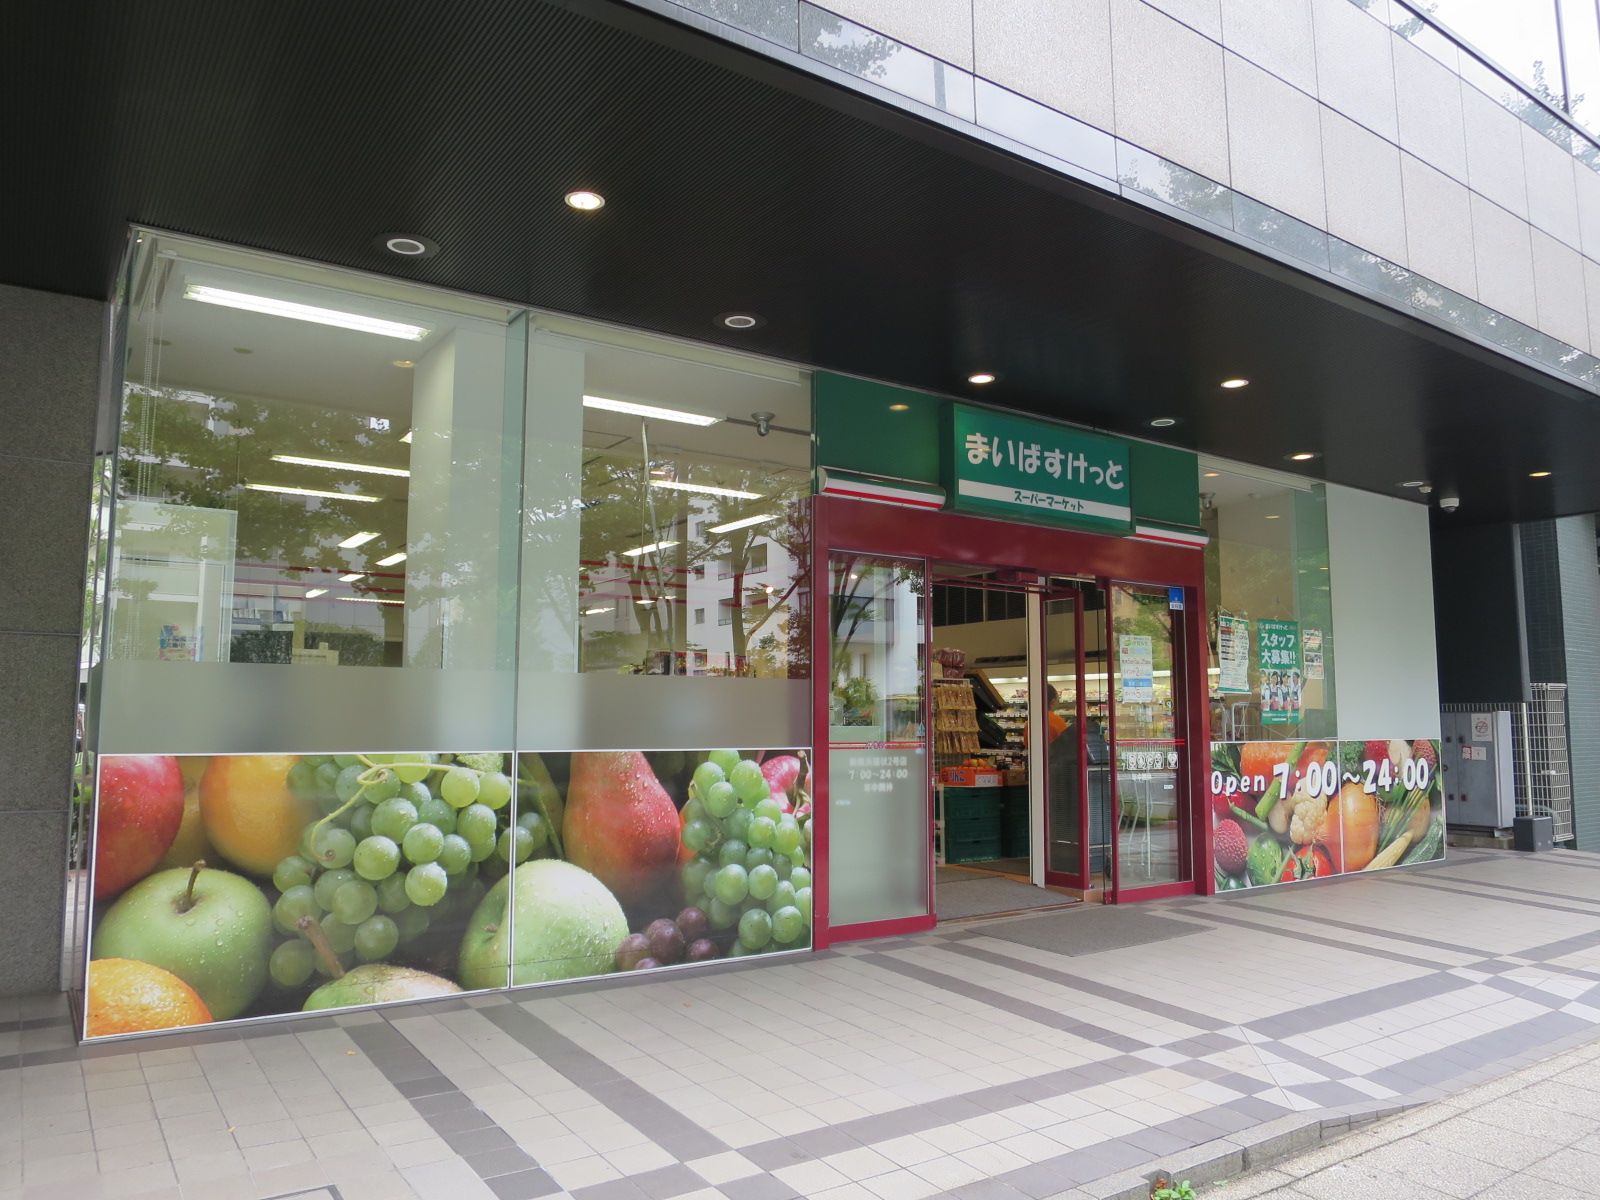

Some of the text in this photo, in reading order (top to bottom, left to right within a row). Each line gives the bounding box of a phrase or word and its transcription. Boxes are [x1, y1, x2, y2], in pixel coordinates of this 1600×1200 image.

[965, 432, 1125, 490] まいばすけっと
[1014, 490, 1084, 512] スーパーマーケット
[1261, 633, 1295, 649] スタッフ
[1211, 770, 1265, 796] Open
